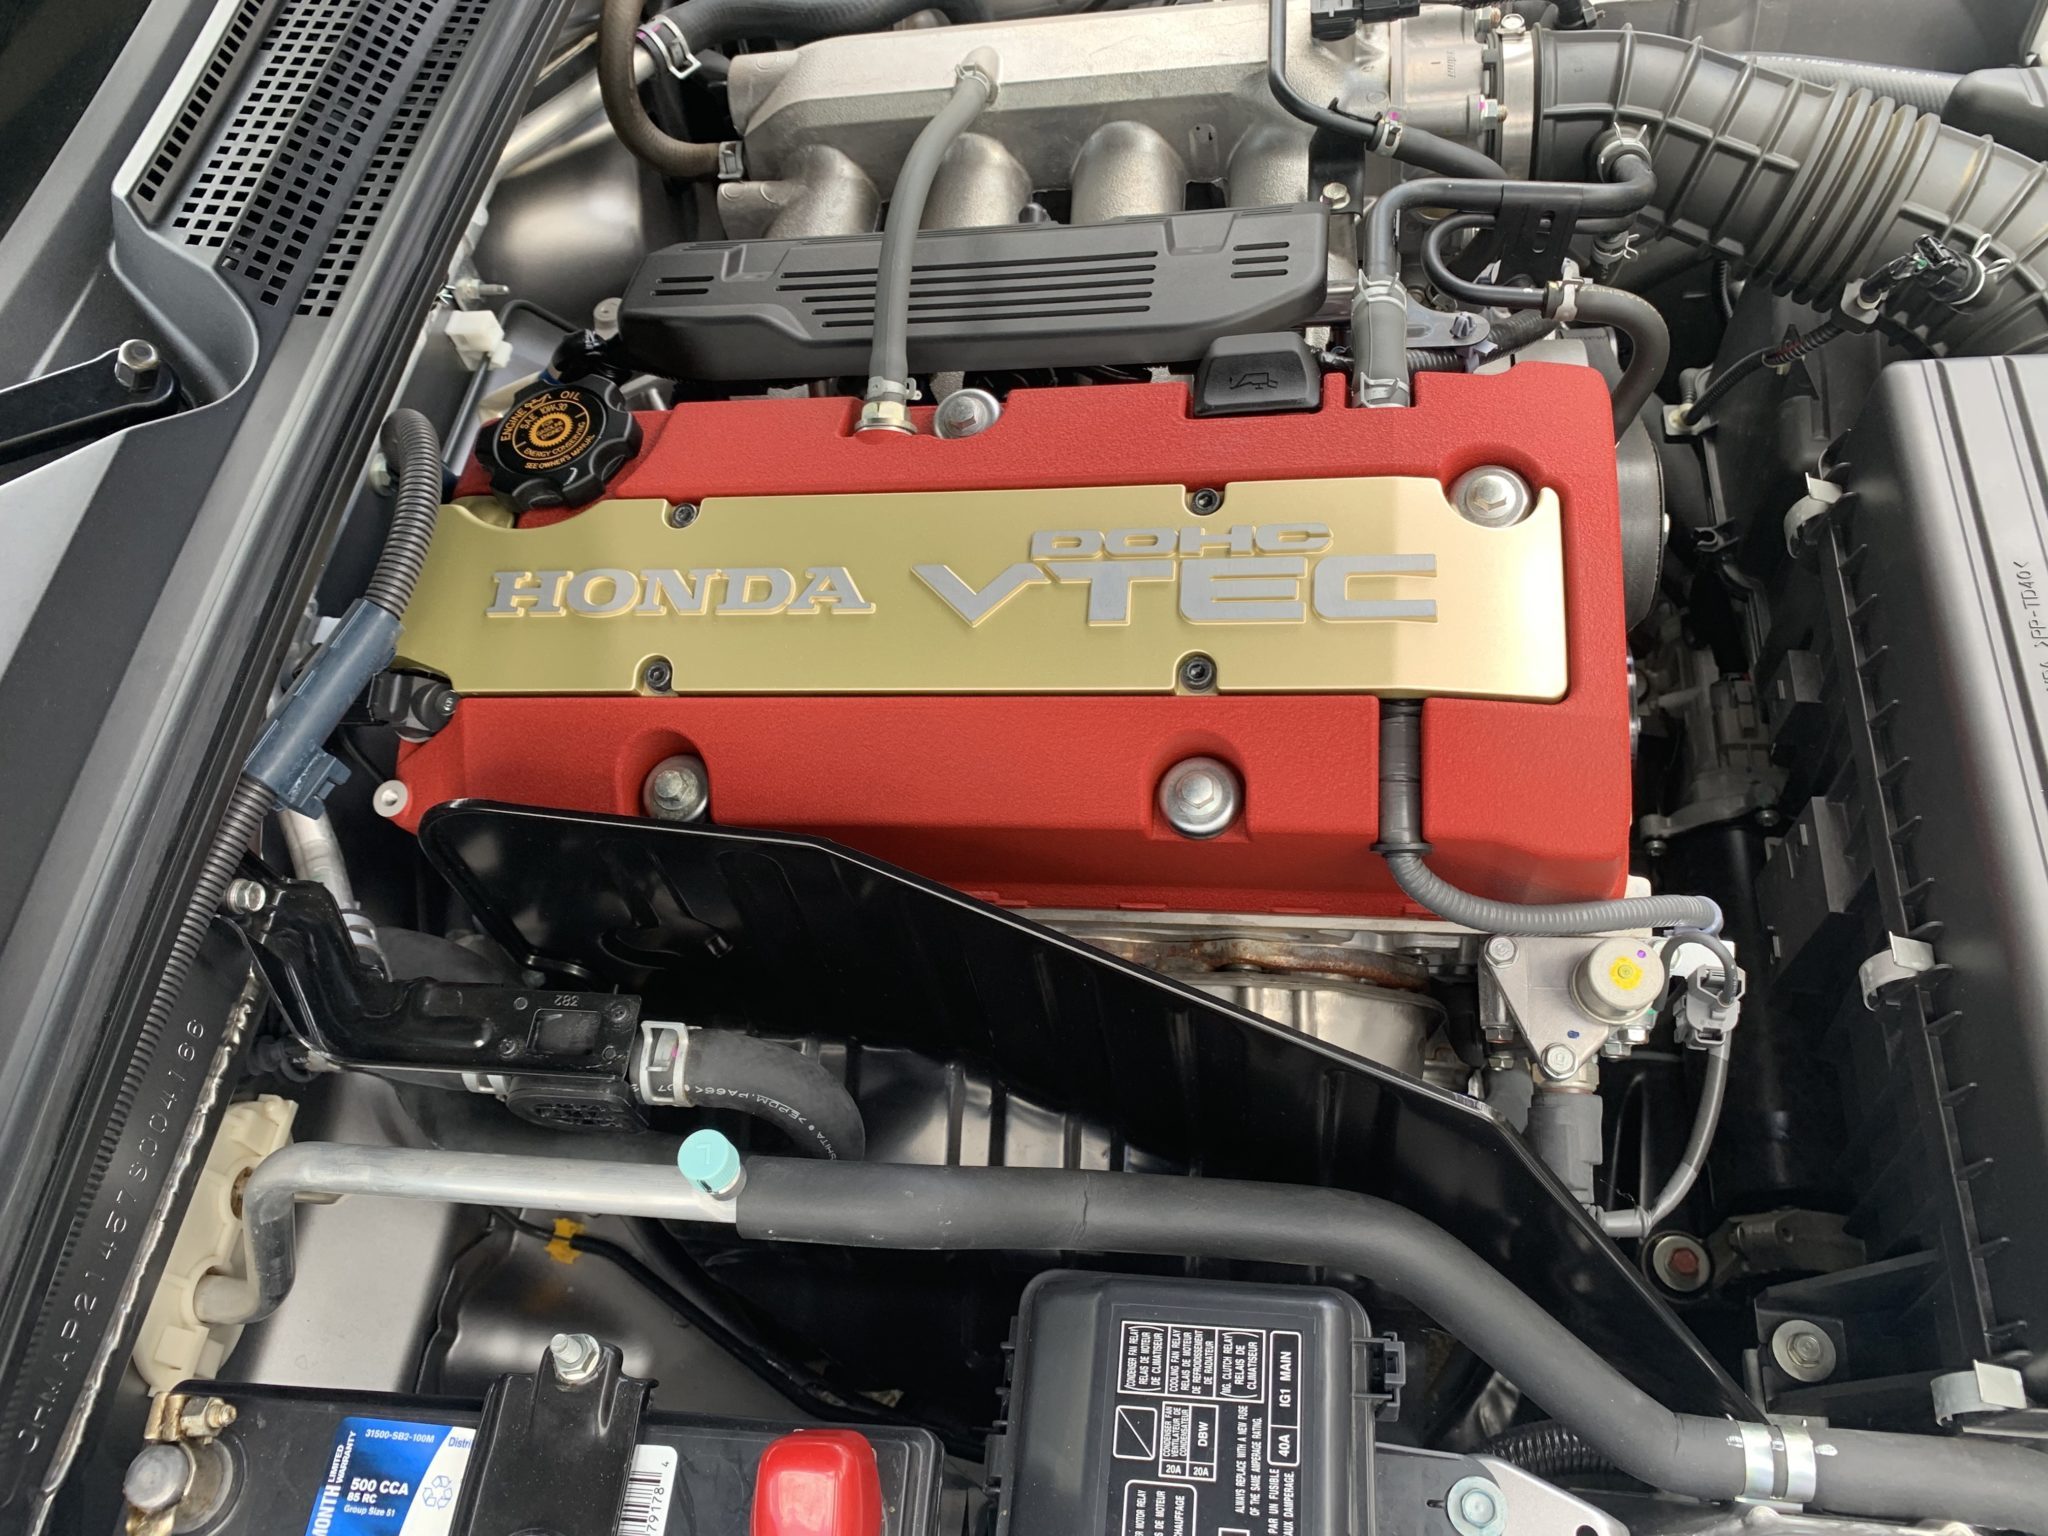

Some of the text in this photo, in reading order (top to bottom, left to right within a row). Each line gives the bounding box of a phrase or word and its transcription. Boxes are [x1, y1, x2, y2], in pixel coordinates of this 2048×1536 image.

[501, 391, 580, 442] ENGINE OIL
[520, 413, 538, 430] SAE
[523, 421, 586, 457] ENERGY CONSERVING
[538, 454, 571, 469] OWNER'S
[571, 434, 596, 457] MANUAL
[1029, 522, 1334, 561] DOHC
[486, 554, 1439, 628] HONDA VTEC
[695, 1143, 712, 1166] L
[1126, 1328, 1139, 1386] CONDENSER FAN RELAY
[1139, 1332, 1151, 1385] RELAIS DE MOTEUR
[1151, 1332, 1163, 1386] DE CLIMATISEUR
[1169, 1329, 1181, 1392] COOLING FAN RELAY
[1181, 1332, 1192, 1391] RELAIS DE MOTEUR
[1192, 1330, 1203, 1394] DE REFROIDISSEMENT
[1223, 1335, 1233, 1354] RELAY
[1204, 1341, 1214, 1385] DE RADIATEUR
[1222, 1356, 1232, 1380] CLUTCH
[1235, 1345, 1245, 1386] RELAIS DE
[1247, 1342, 1258, 1390] CLIMATISEUR
[1238, 1405, 1248, 1420] FUSE
[1278, 1351, 1292, 1457] 40A IG1 MAIN
[365, 1429, 435, 1443] 31500-SB2-100M
[1163, 1406, 1173, 1457] CONDENSER FAN
[1171, 1407, 1181, 1457] VENTILATEUR DE
[1179, 1409, 1189, 1457] CONDENSATEUR
[1197, 1421, 1209, 1447] DBW
[1237, 1422, 1247, 1435] NEW
[327, 1445, 344, 1483] LIMITED
[336, 1430, 356, 1484] WARRANTY
[1237, 1444, 1246, 1458] WITH
[1249, 1417, 1262, 1516] OF THE SAME AMPERAGE RATING.
[351, 1477, 408, 1495] 500 CCA
[1165, 1464, 1182, 1474] 20A
[1193, 1466, 1209, 1477] 20A
[1236, 1460, 1246, 1487] REPLACE
[344, 1504, 396, 1517] Group Size 51
[347, 1492, 377, 1504] 85 RC
[1136, 1490, 1146, 1508] RELAY
[1155, 1490, 1165, 1517] MOTEUR
[1235, 1489, 1245, 1514] ALWAYS
[1268, 1469, 1279, 1534] PAR UN FUSIBLE
[1135, 1509, 1145, 1529] MOTOR
[1155, 1520, 1164, 1529] DE
